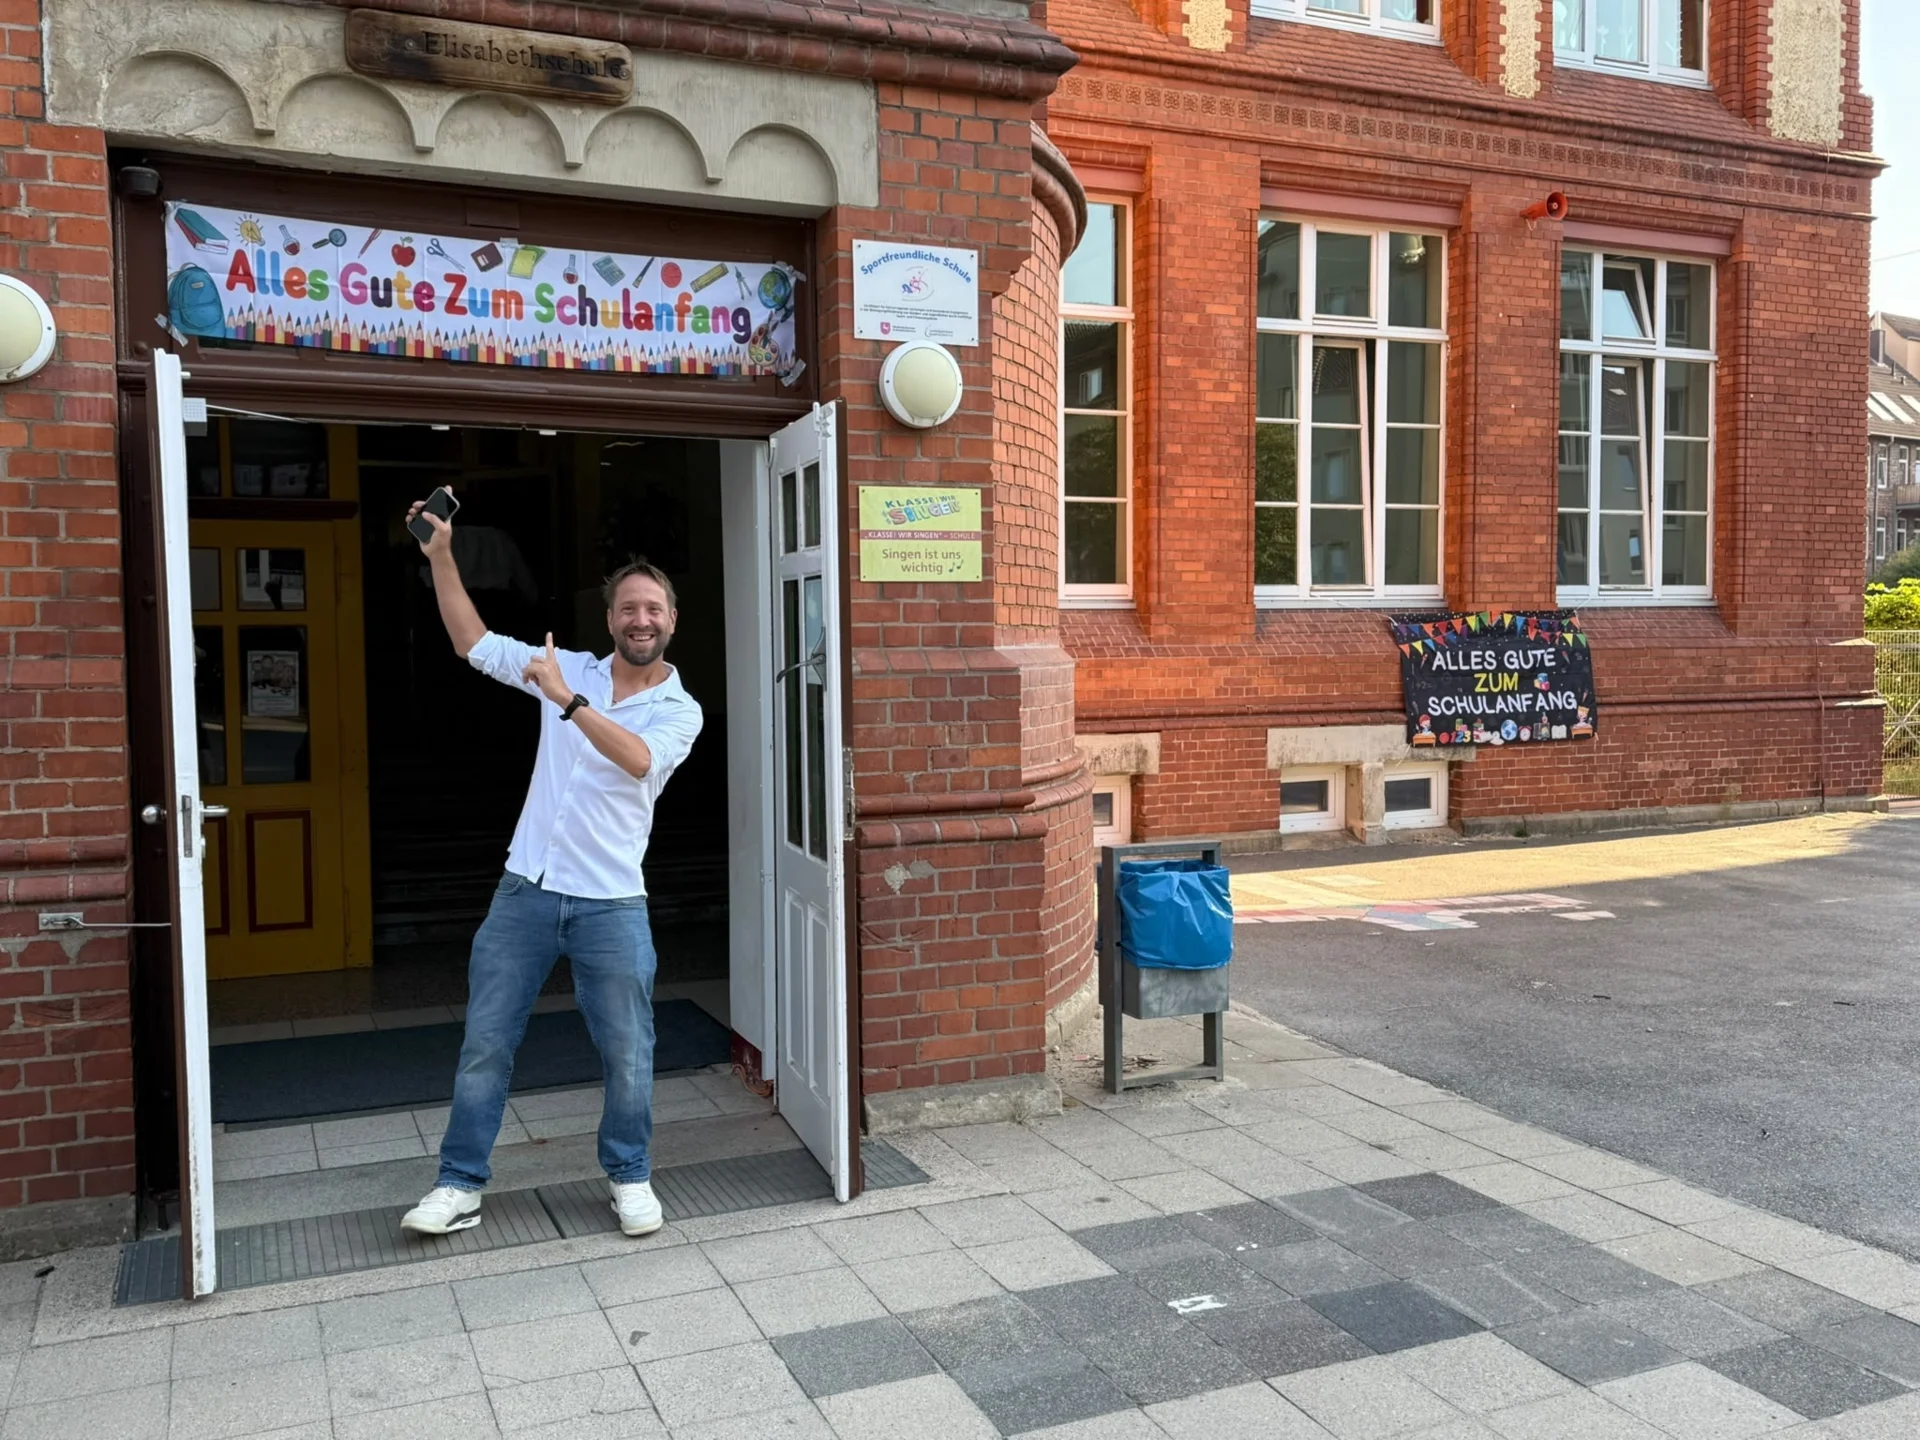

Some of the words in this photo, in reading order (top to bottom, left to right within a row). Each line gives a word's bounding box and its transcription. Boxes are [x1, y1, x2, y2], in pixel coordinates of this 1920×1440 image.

[421, 30, 622, 79] Elisabethschule
[860, 250, 941, 276] Sportfreundliche
[942, 257, 972, 284] Schule
[225, 248, 330, 301] Alles
[339, 262, 436, 312] Gute
[443, 272, 524, 321] Zum
[534, 282, 752, 345] Schulanfang
[898, 531, 912, 539] WIR
[949, 532, 976, 540] SCHULE
[882, 549, 921, 561] Singen
[925, 549, 938, 559] ist
[942, 551, 961, 560] uns
[901, 562, 943, 575] wichtig
[1432, 650, 1497, 671] ALLES
[1504, 648, 1556, 670] GUTE
[1473, 672, 1519, 693] ZUM
[1427, 691, 1578, 716] SCHULANFANG
